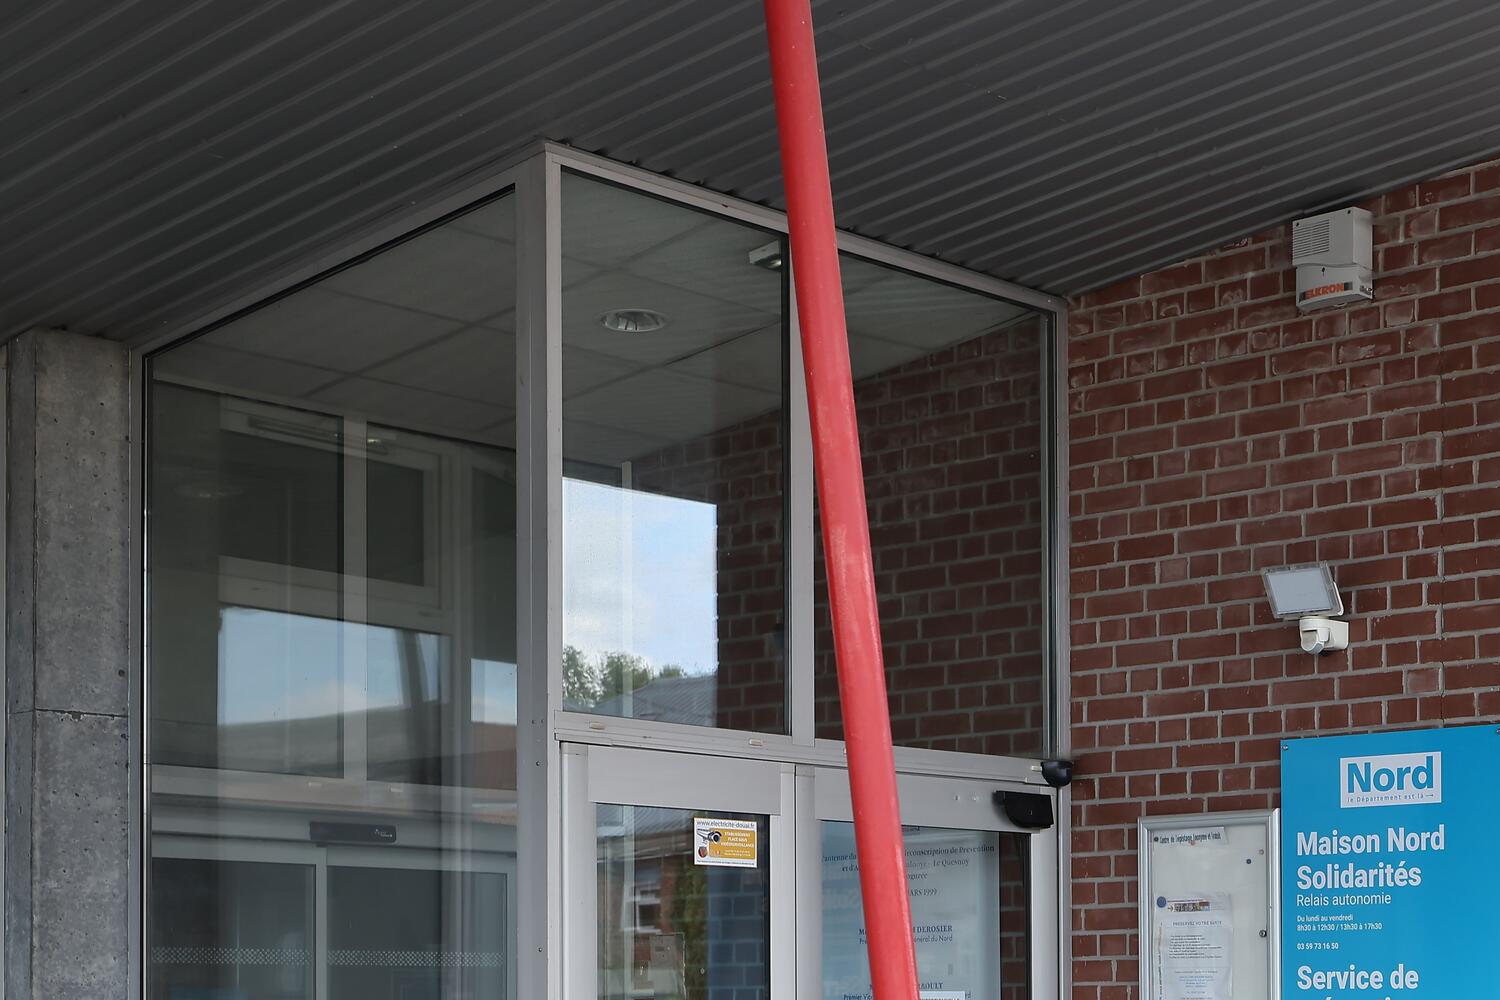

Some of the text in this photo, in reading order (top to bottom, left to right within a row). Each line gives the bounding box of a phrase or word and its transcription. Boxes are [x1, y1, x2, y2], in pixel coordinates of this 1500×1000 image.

[1347, 755, 1434, 793] Nord
[1357, 794, 1403, 803] Département
[1297, 824, 1445, 856] Maison Nord
[1297, 861, 1422, 890] Solidarités
[1296, 892, 1392, 907] Relais autonomie
[938, 934, 953, 942] Nord
[1297, 963, 1419, 990] Service de
